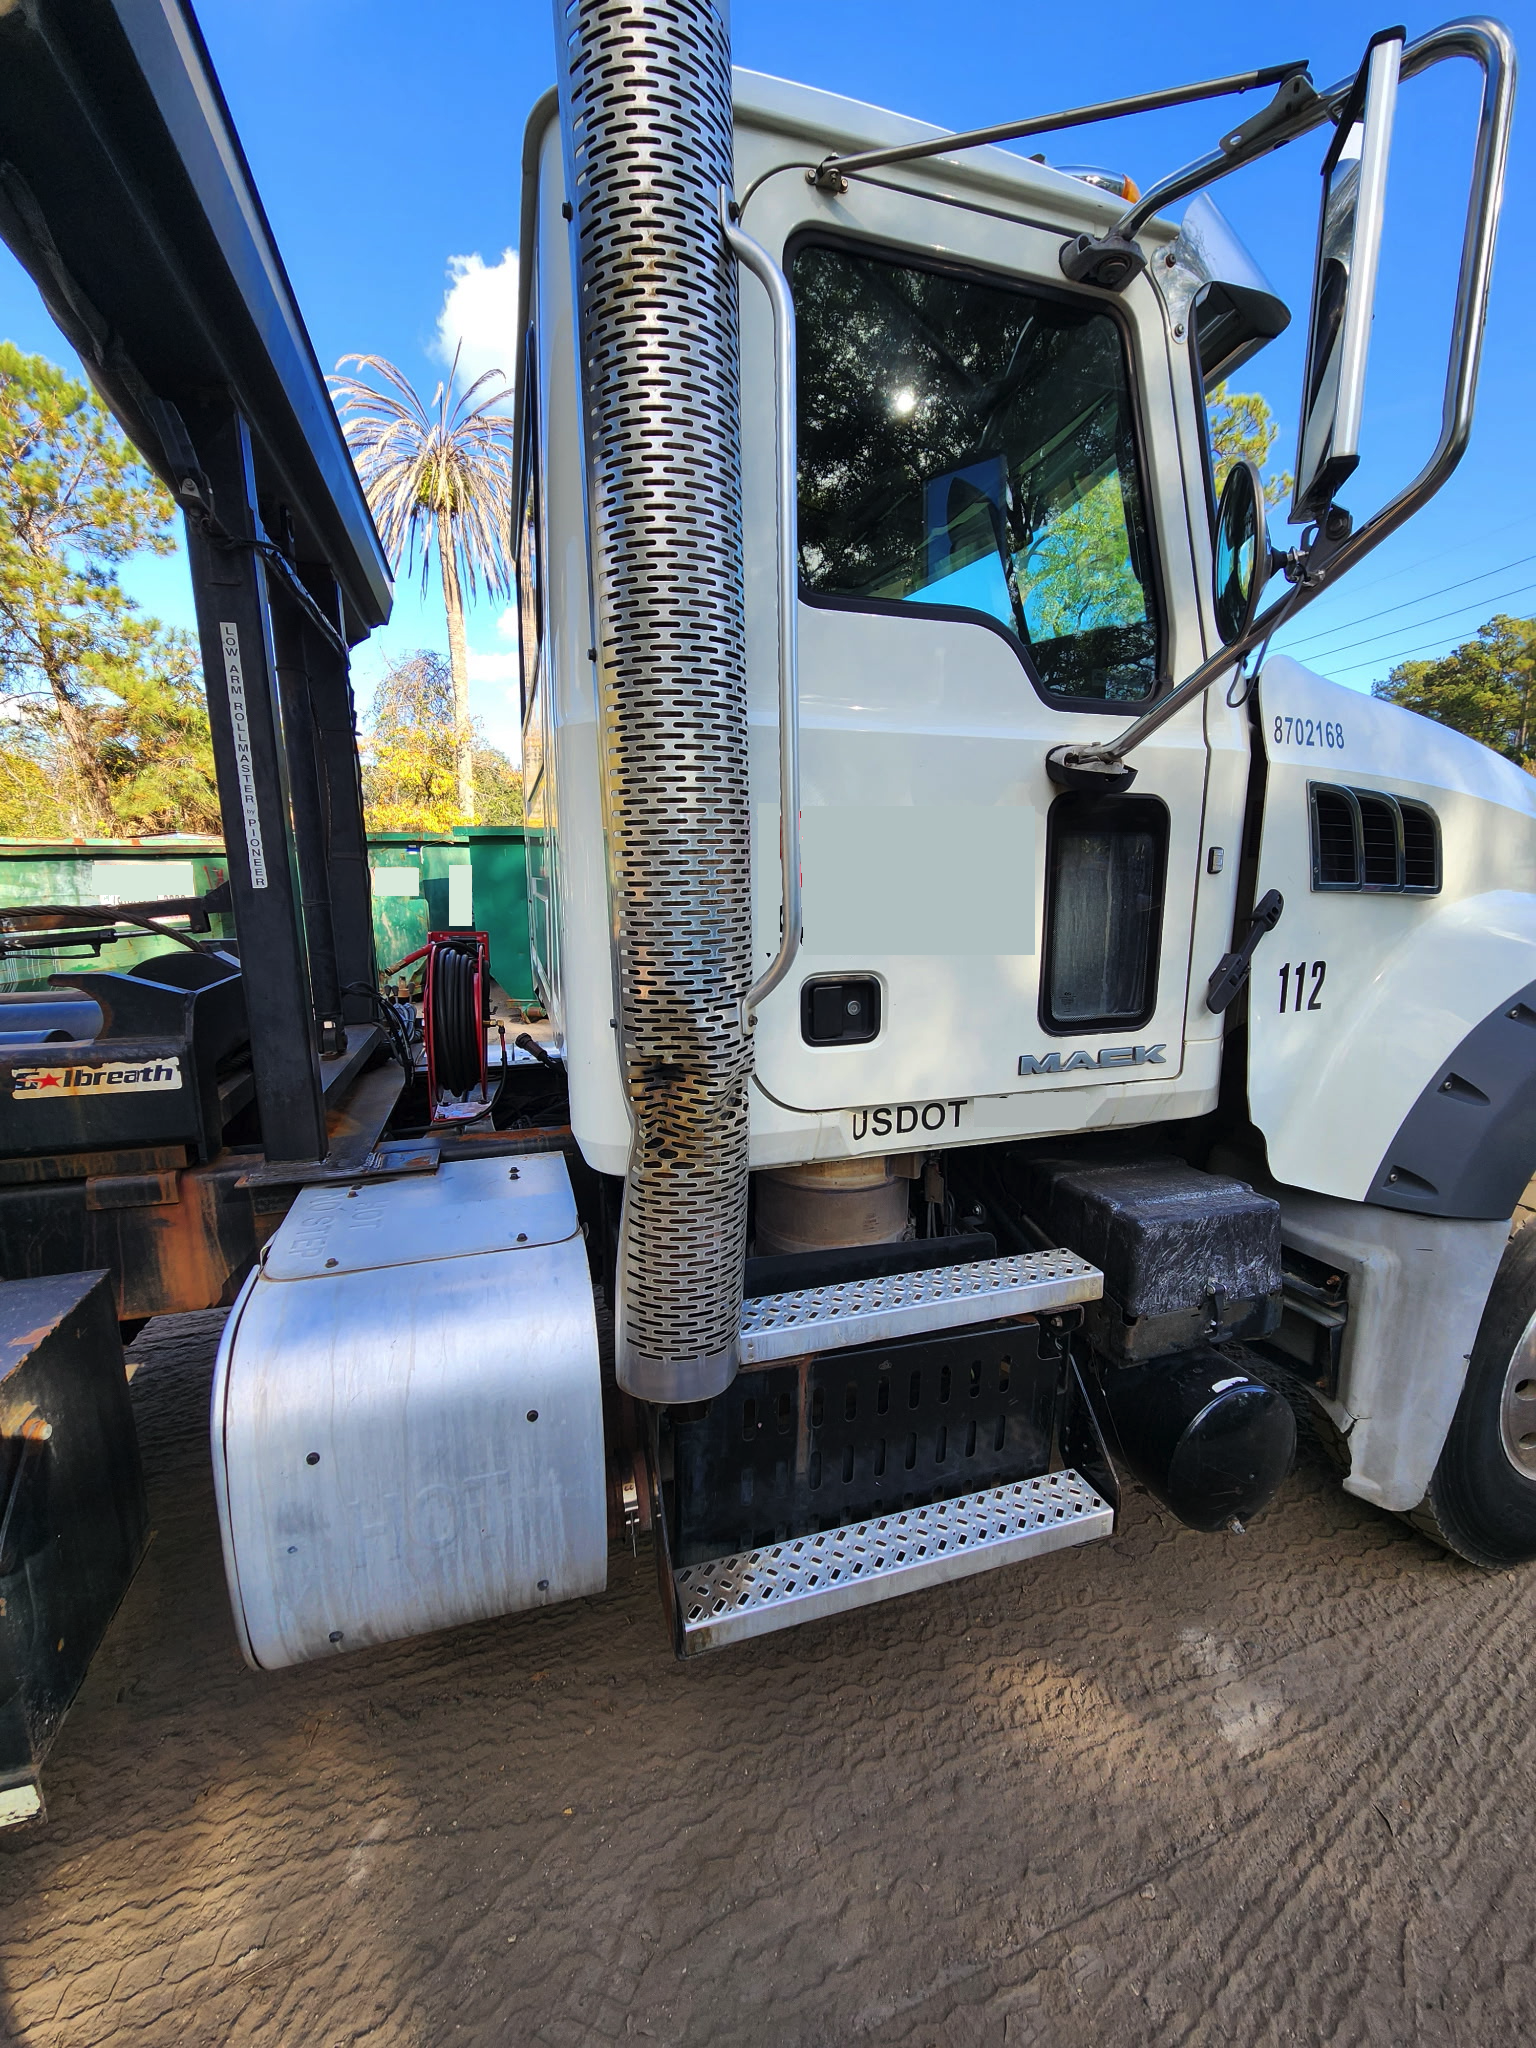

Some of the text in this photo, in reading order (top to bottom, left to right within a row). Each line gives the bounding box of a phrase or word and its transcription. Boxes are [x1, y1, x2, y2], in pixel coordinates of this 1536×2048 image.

[1273, 715, 1345, 750] 8702168
[225, 626, 265, 887] LOW ARM ROLLMASTER by PIONEER
[1278, 960, 1327, 1014] 112
[15, 1063, 174, 1091] Glbreath
[1017, 1043, 1167, 1076] MACK
[852, 1099, 968, 1141] USDOT
[287, 1215, 335, 1259] STEP
